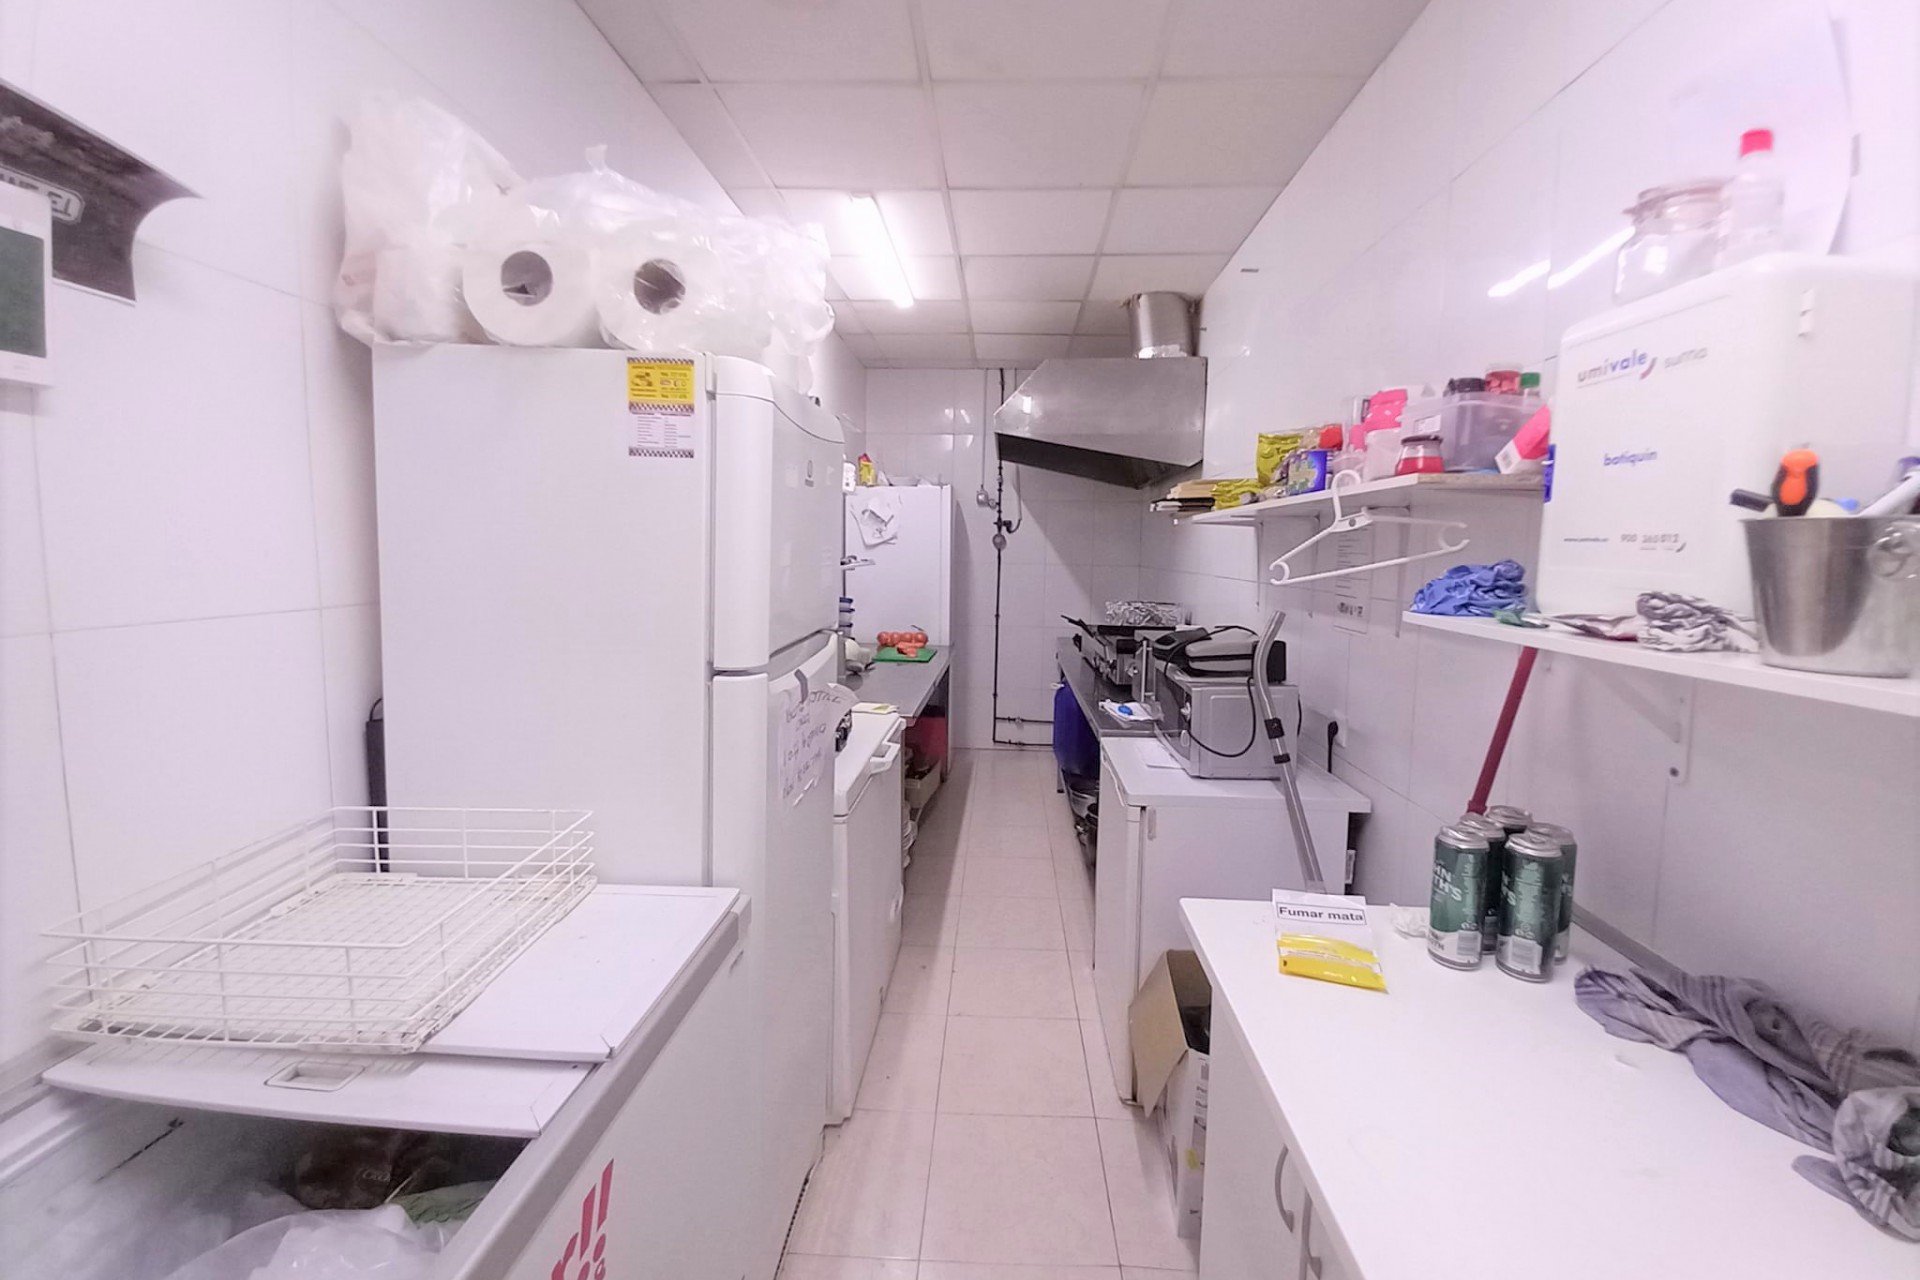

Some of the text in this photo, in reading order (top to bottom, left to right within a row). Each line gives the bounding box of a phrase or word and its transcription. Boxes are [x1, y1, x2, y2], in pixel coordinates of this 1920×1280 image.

[1577, 349, 1647, 382] umivale
[1279, 906, 1363, 921] Fumar mata
